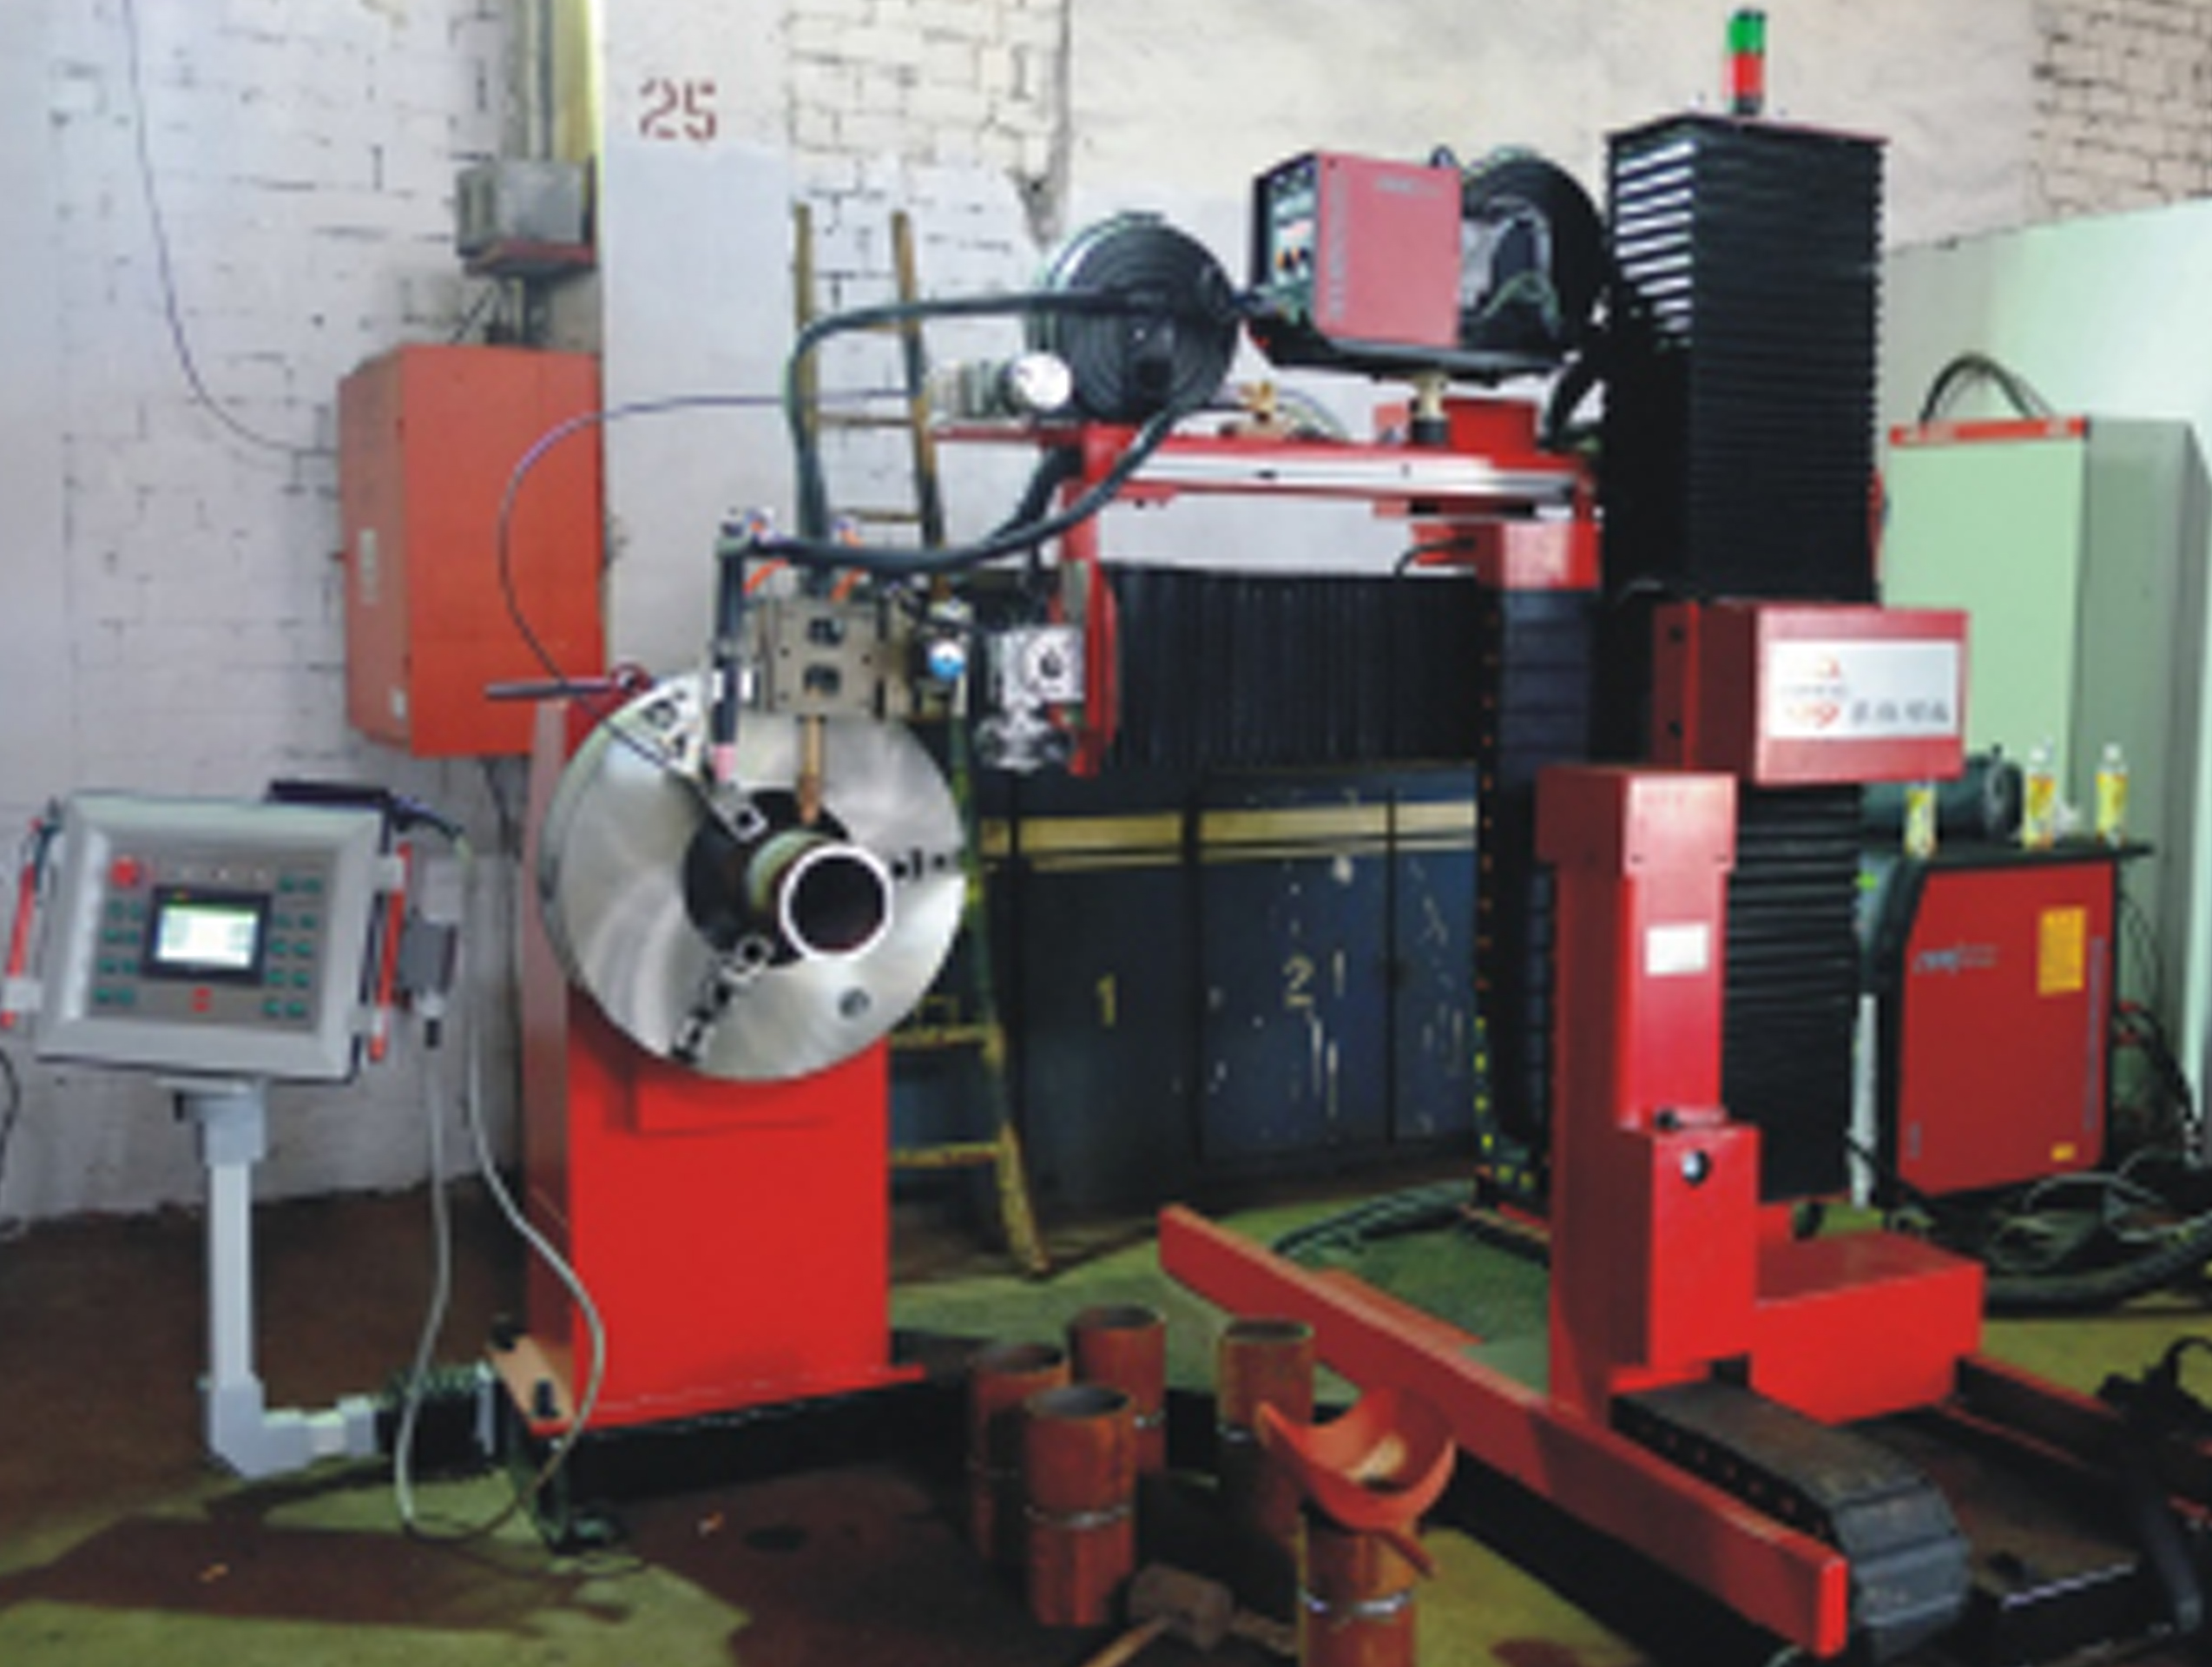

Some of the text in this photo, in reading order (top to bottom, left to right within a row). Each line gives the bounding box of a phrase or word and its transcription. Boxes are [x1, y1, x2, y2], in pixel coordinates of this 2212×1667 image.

[639, 78, 717, 142] 25
[1096, 973, 1116, 1026] 1
[1282, 954, 1314, 1008] 2
